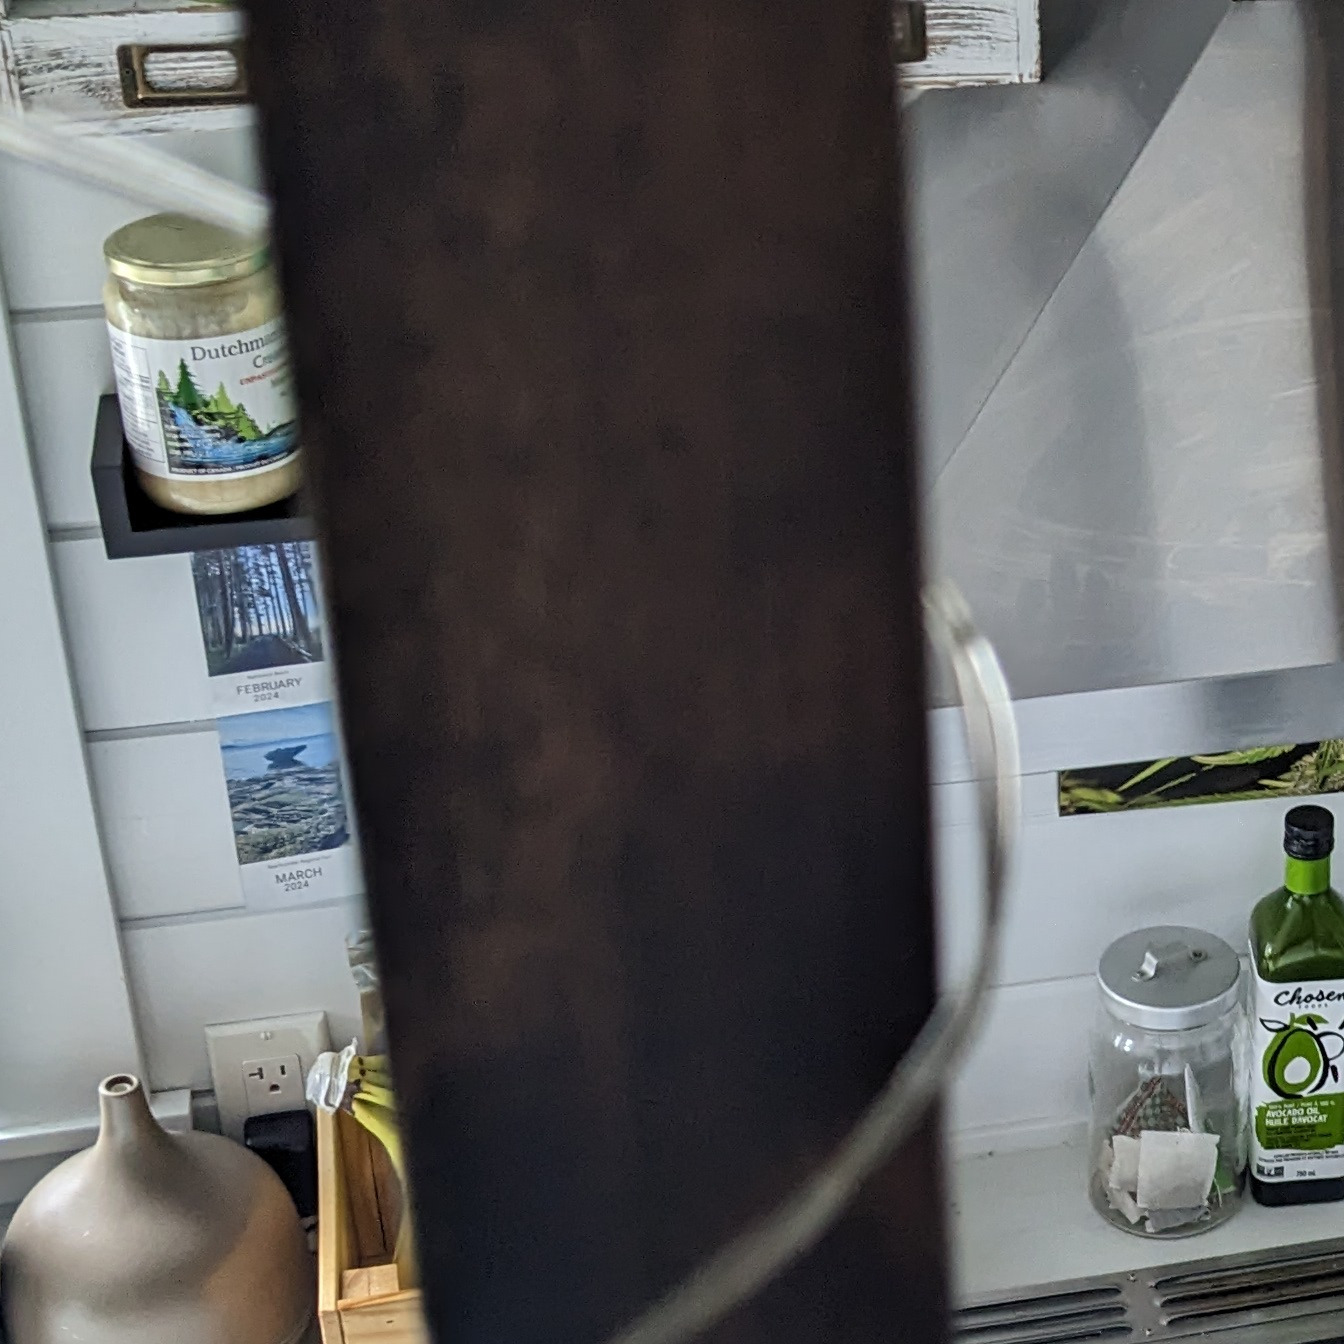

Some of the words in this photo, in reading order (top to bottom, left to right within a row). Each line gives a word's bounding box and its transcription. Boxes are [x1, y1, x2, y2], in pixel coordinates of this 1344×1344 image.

[190, 329, 284, 361] Dutchm
[236, 677, 302, 695] FEBRUARY
[253, 691, 280, 703] 2024
[275, 867, 323, 884] MARCH
[284, 880, 309, 892] 2024
[1266, 1108, 1304, 1117] AVOCADO
[1306, 1107, 1320, 1115] OIL
[1265, 1117, 1288, 1126] HUILE
